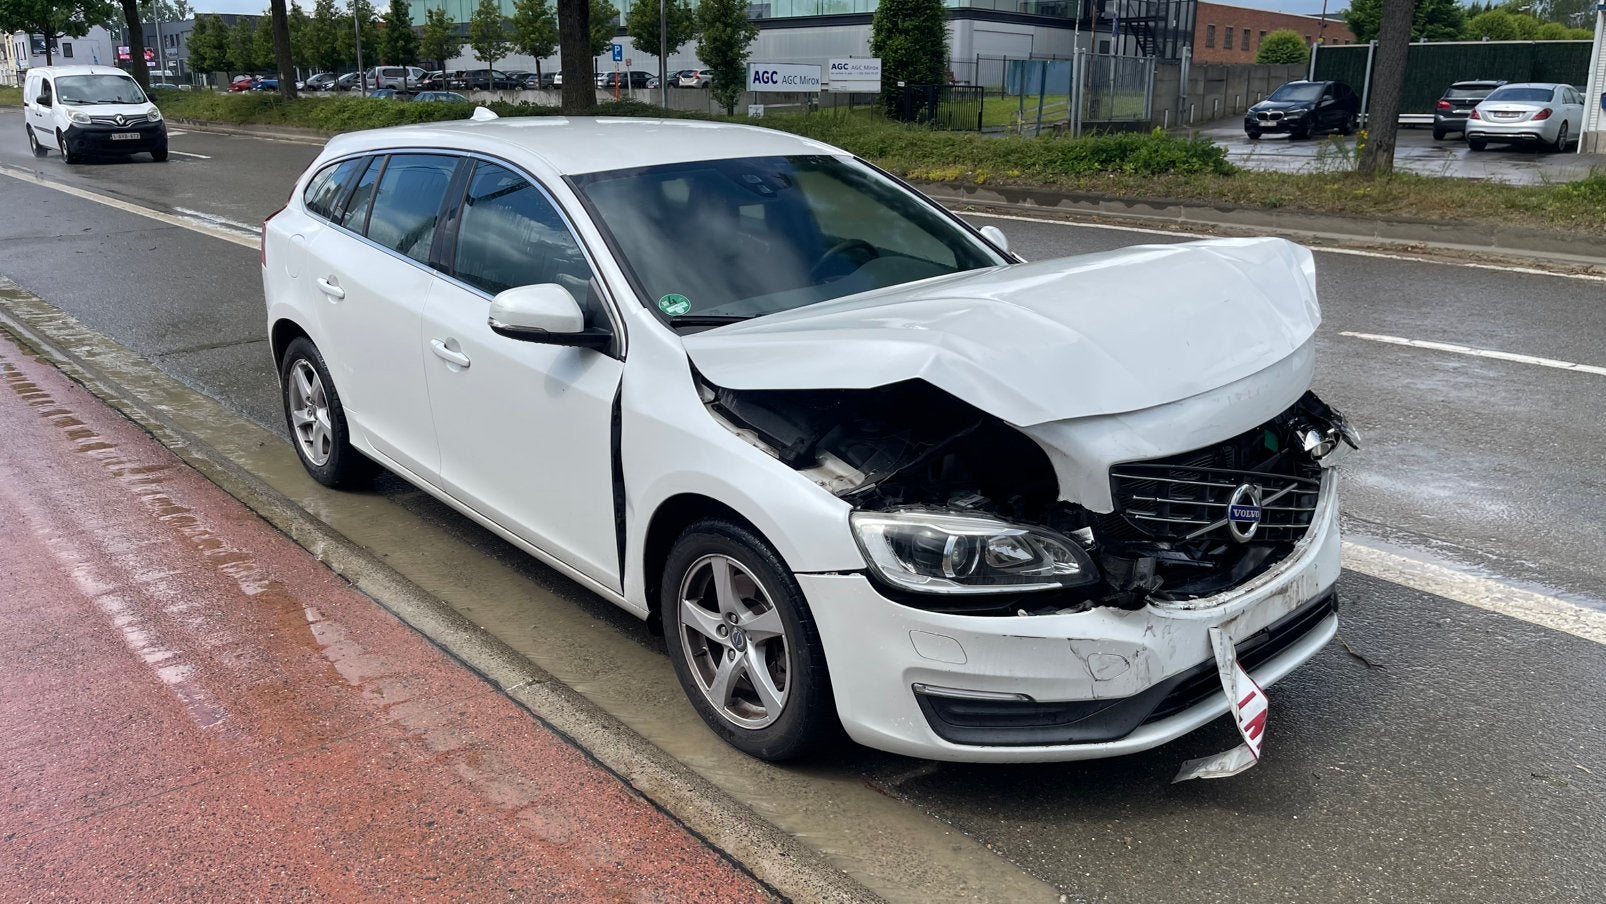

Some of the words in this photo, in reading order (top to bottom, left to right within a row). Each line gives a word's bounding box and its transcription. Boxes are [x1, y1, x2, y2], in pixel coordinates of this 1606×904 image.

[614, 45, 621, 55] P
[753, 70, 778, 84] AGC
[782, 75, 798, 85] AGC
[800, 75, 820, 85] Mirox
[1233, 509, 1260, 518] VOLVO
